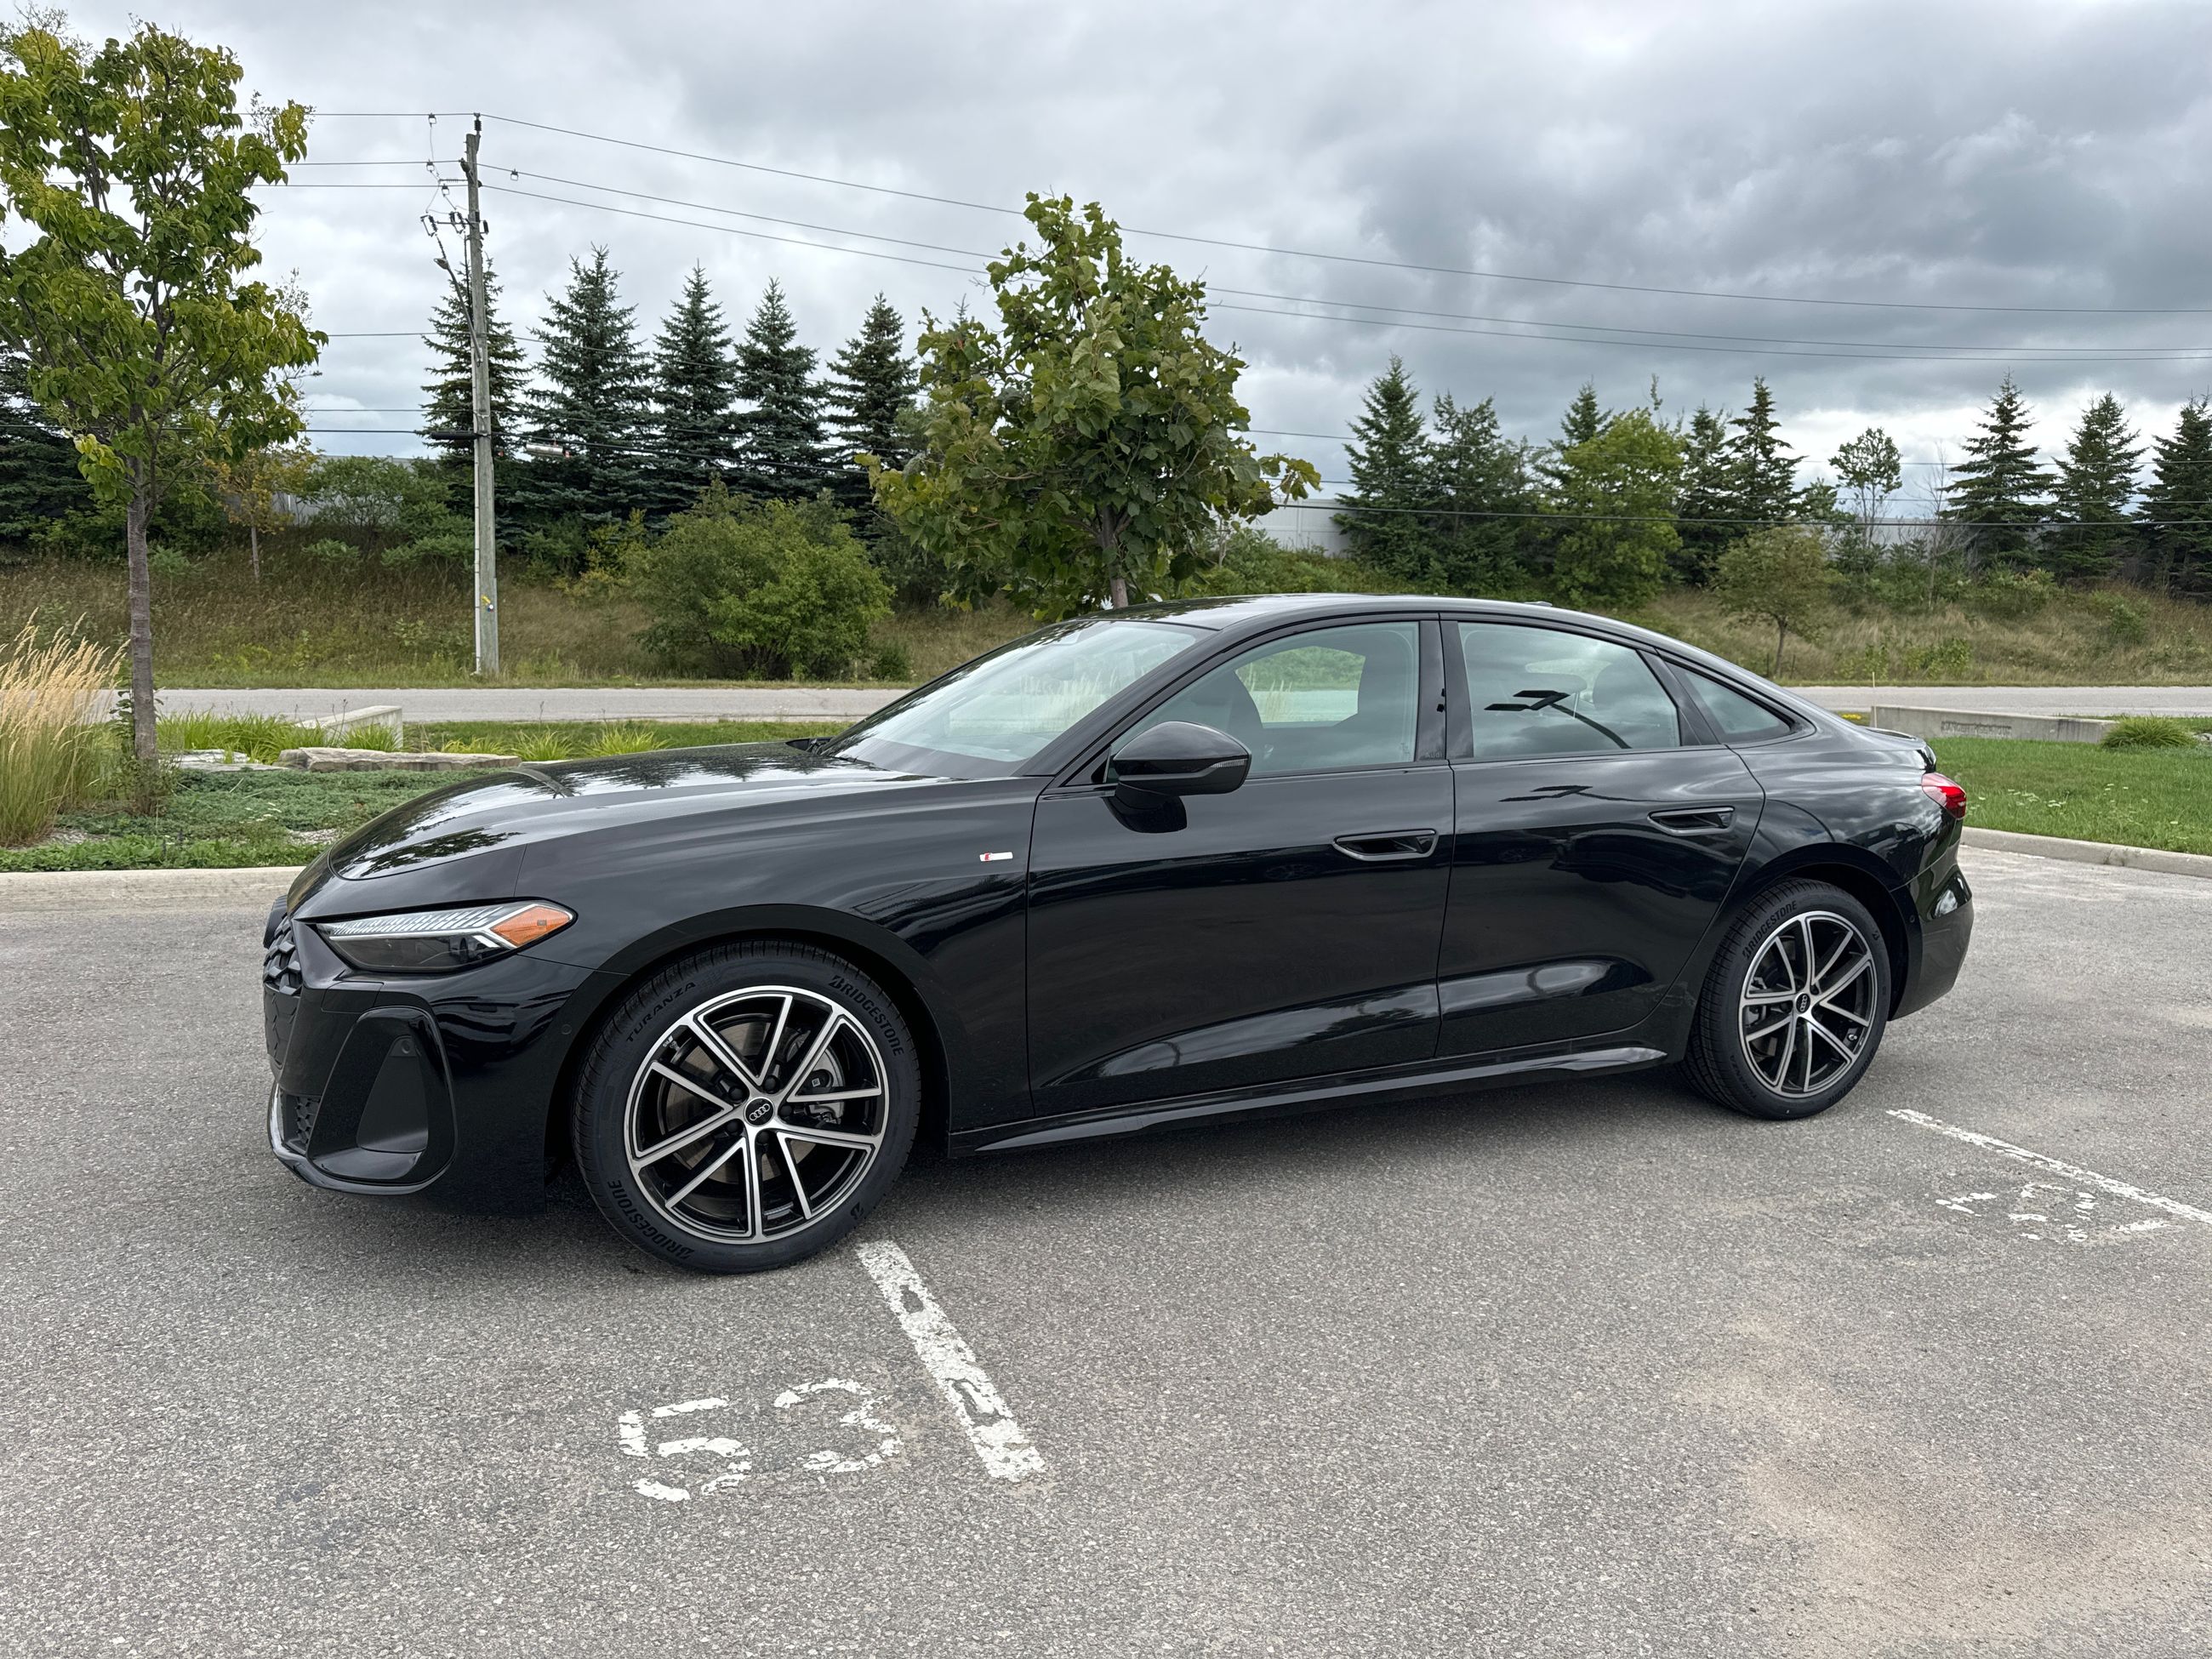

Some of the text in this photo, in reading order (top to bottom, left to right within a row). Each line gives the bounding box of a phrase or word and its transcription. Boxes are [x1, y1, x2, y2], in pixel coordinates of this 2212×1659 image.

[1742, 900, 1798, 960] BRIDGESTONE
[626, 982, 696, 1042] TURANZA
[829, 975, 904, 1057] BRIDGESTONE
[607, 1179, 695, 1260] BRIDGESTONE
